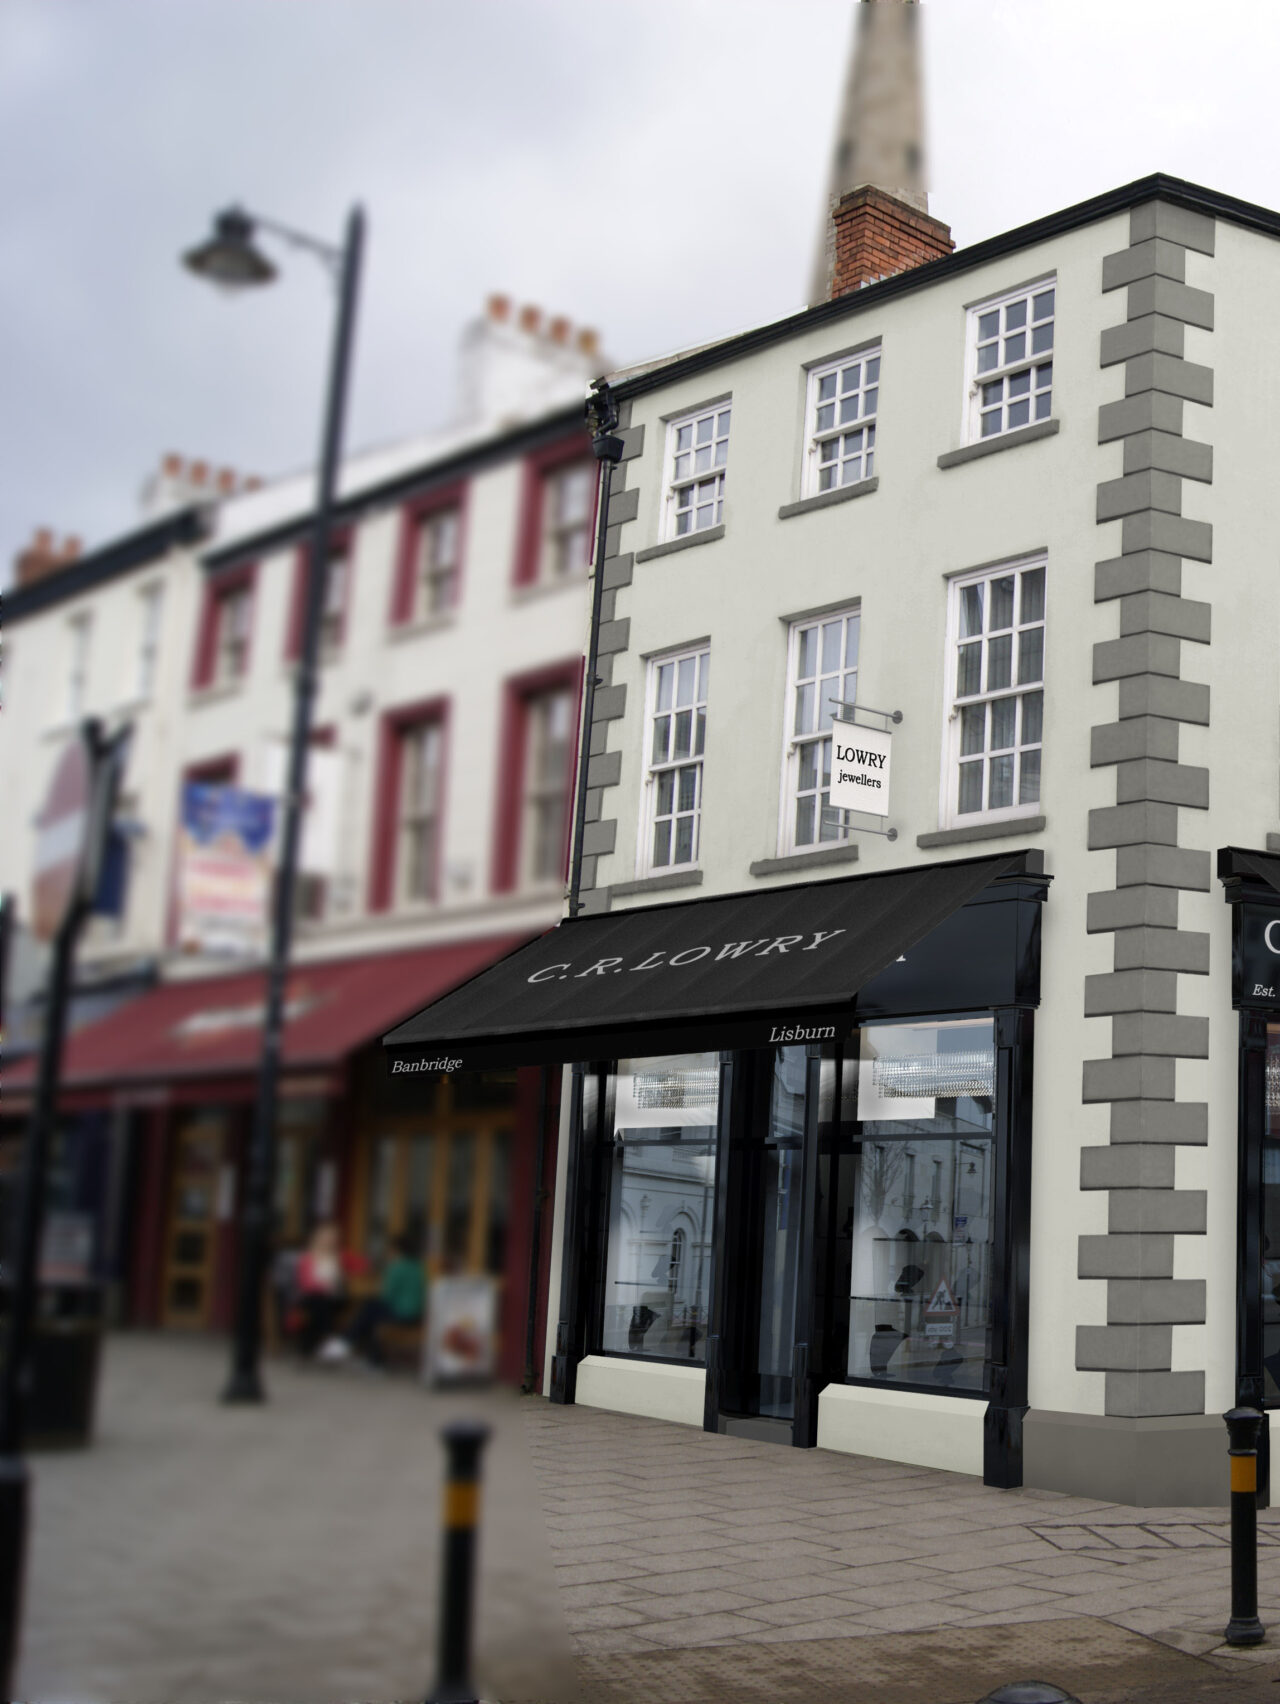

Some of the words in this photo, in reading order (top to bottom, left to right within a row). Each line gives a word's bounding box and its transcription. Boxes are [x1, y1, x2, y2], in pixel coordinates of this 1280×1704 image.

[837, 745, 886, 769] LOWRY
[838, 770, 881, 788] jewellers
[1252, 983, 1275, 998] Est.
[769, 1024, 836, 1043] Lisburn
[392, 1057, 463, 1073] Banbridge
